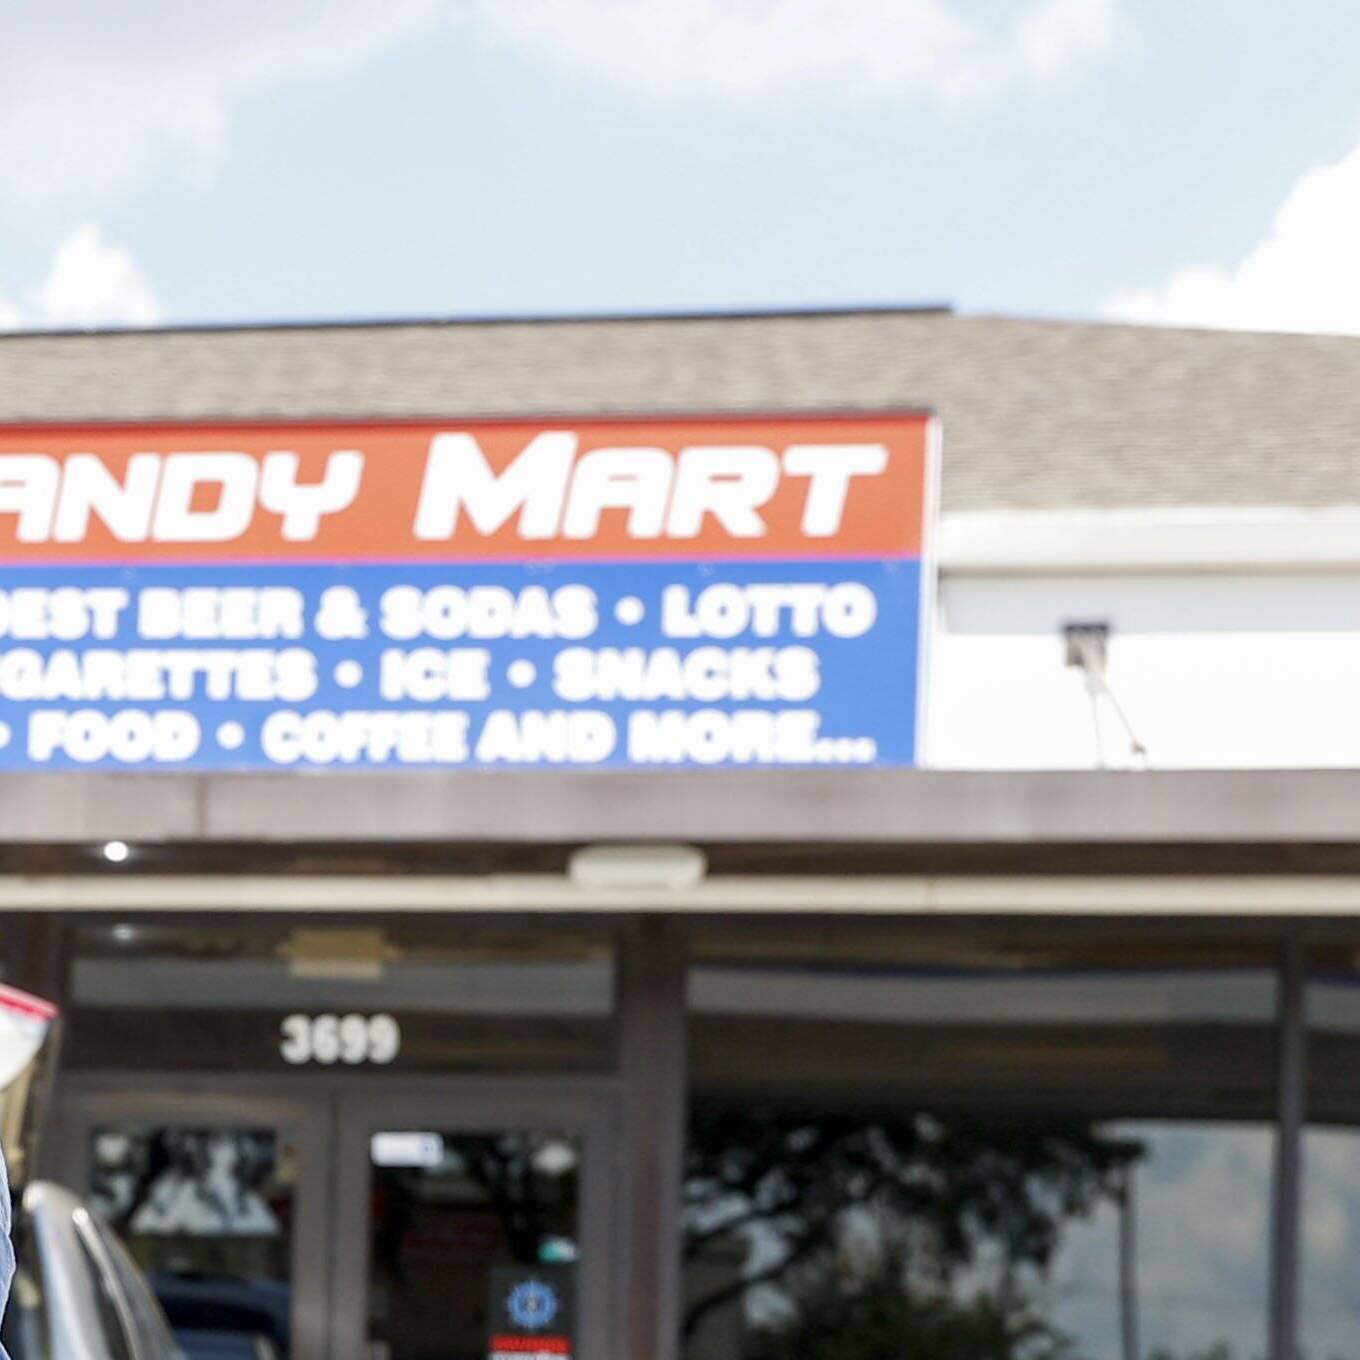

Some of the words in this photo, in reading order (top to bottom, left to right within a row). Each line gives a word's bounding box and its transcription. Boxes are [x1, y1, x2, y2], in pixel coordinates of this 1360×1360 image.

[413, 430, 890, 541] MART
[137, 586, 305, 643] BEER
[315, 586, 367, 641] &
[379, 585, 599, 641] SODAS
[661, 582, 878, 639] LOTTO
[379, 646, 492, 702] ICE
[552, 645, 822, 701] SNACKS
[26, 708, 202, 764] FOOD
[260, 709, 471, 765] COFFEE
[475, 709, 616, 766] AND
[281, 1013, 400, 1064] 3699
